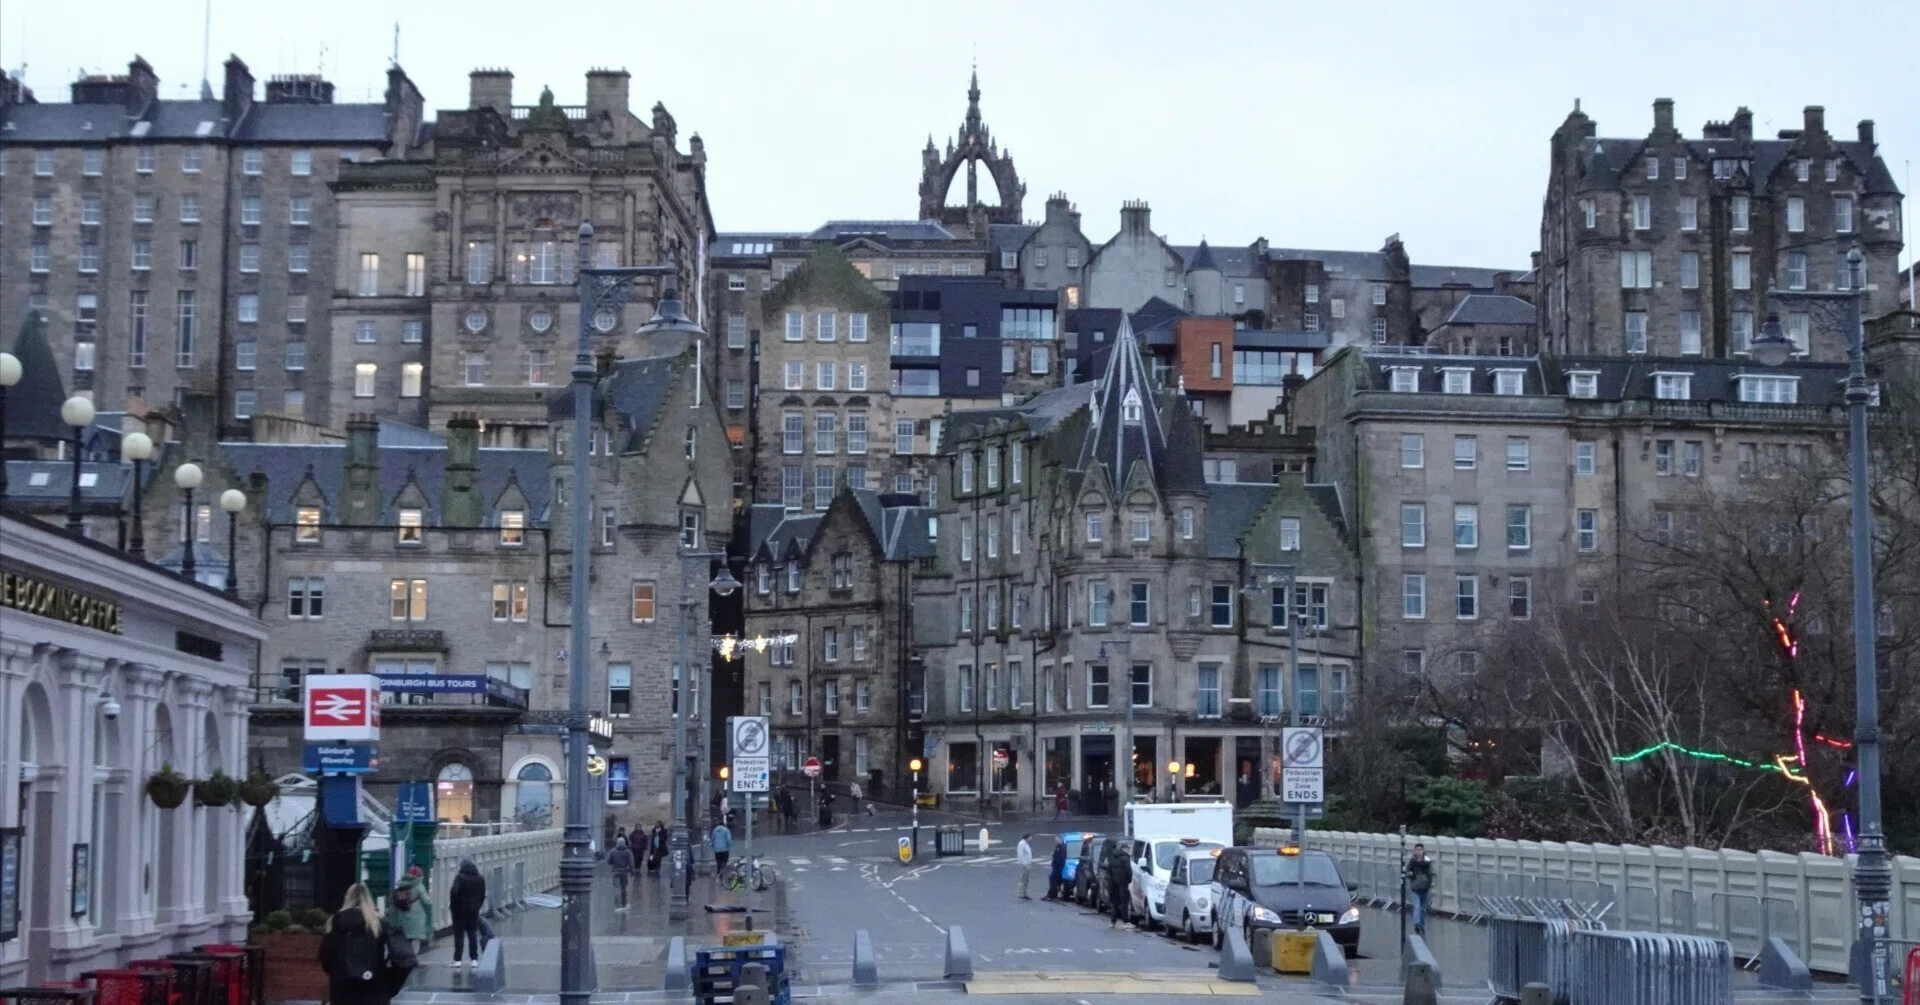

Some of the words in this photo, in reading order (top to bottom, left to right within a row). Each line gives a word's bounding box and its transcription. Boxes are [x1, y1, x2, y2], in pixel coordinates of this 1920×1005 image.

[15, 575, 79, 623] BOOKING
[80, 595, 123, 635] OFFICE
[381, 679, 426, 688] DINBURGH
[427, 679, 446, 688] BUS
[447, 679, 478, 689] TOURS
[1287, 790, 1319, 799] ENDS
